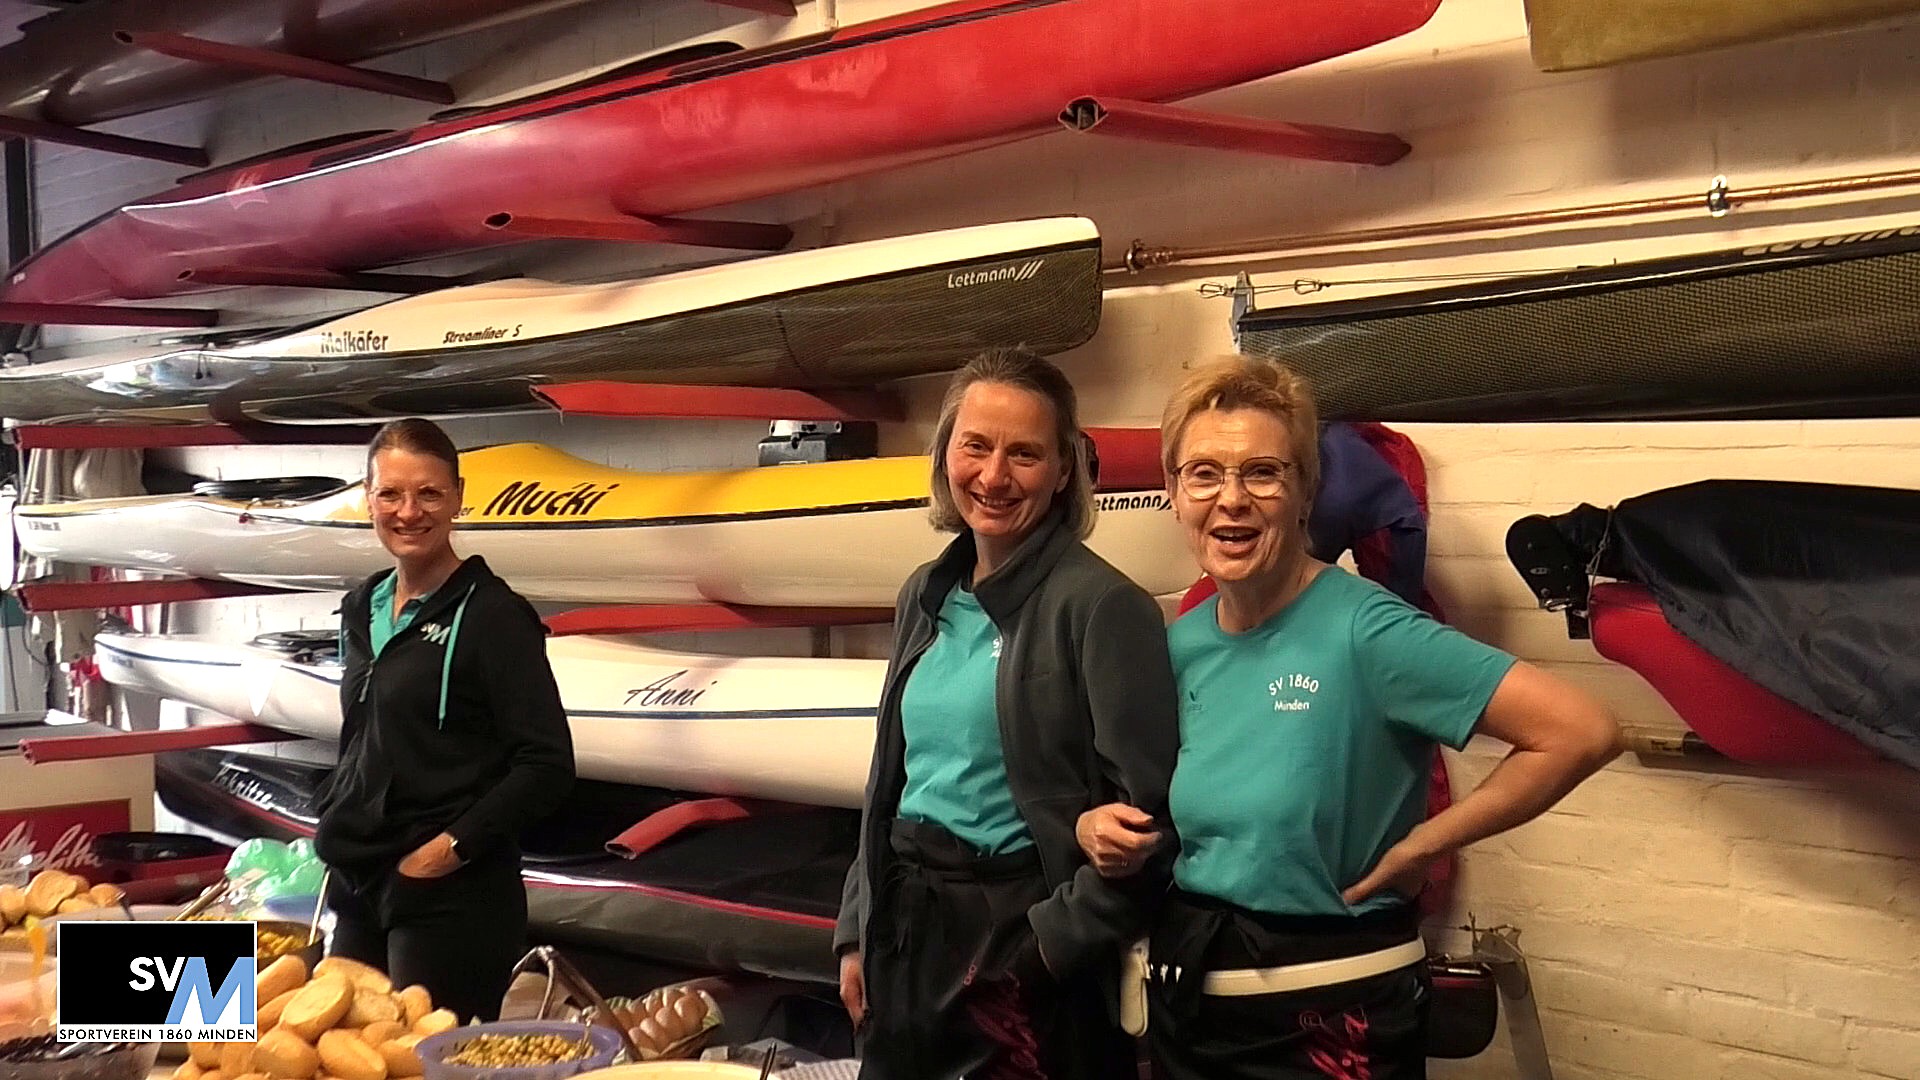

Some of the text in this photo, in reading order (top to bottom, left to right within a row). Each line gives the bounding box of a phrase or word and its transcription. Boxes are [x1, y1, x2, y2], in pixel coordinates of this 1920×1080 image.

[320, 329, 388, 353] Maikäfer
[443, 324, 523, 344] Streamliner S
[1095, 495, 1162, 511] ettmann
[623, 669, 718, 706] Anni
[1269, 673, 1319, 696] SV 1860
[1274, 699, 1310, 711] Minden
